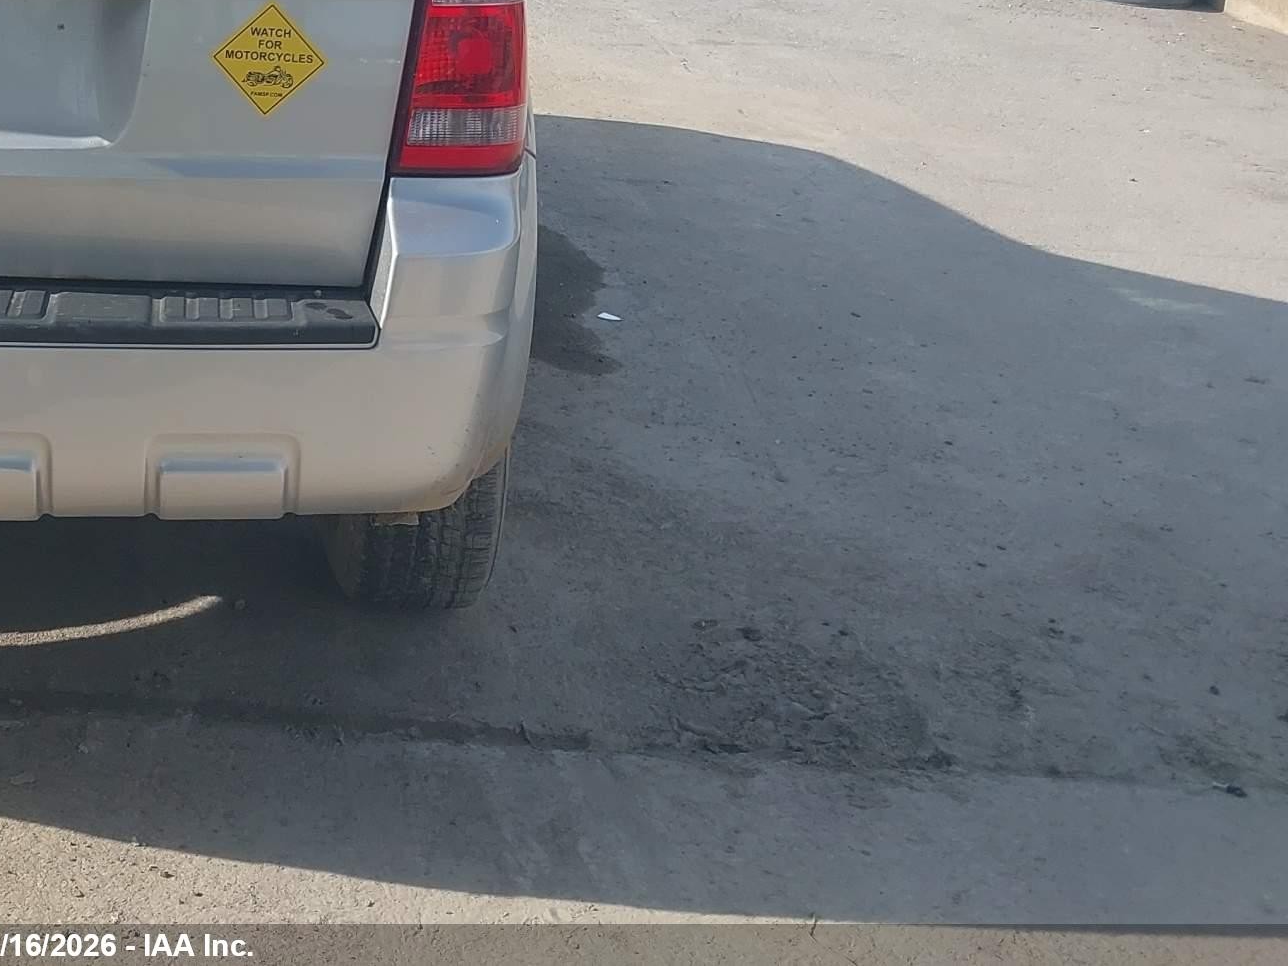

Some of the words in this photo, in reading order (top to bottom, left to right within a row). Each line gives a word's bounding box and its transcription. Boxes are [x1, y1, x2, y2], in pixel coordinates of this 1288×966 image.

[250, 27, 292, 38] WATCH
[258, 40, 282, 50] FOR
[225, 50, 314, 64] MOTORCYCLES
